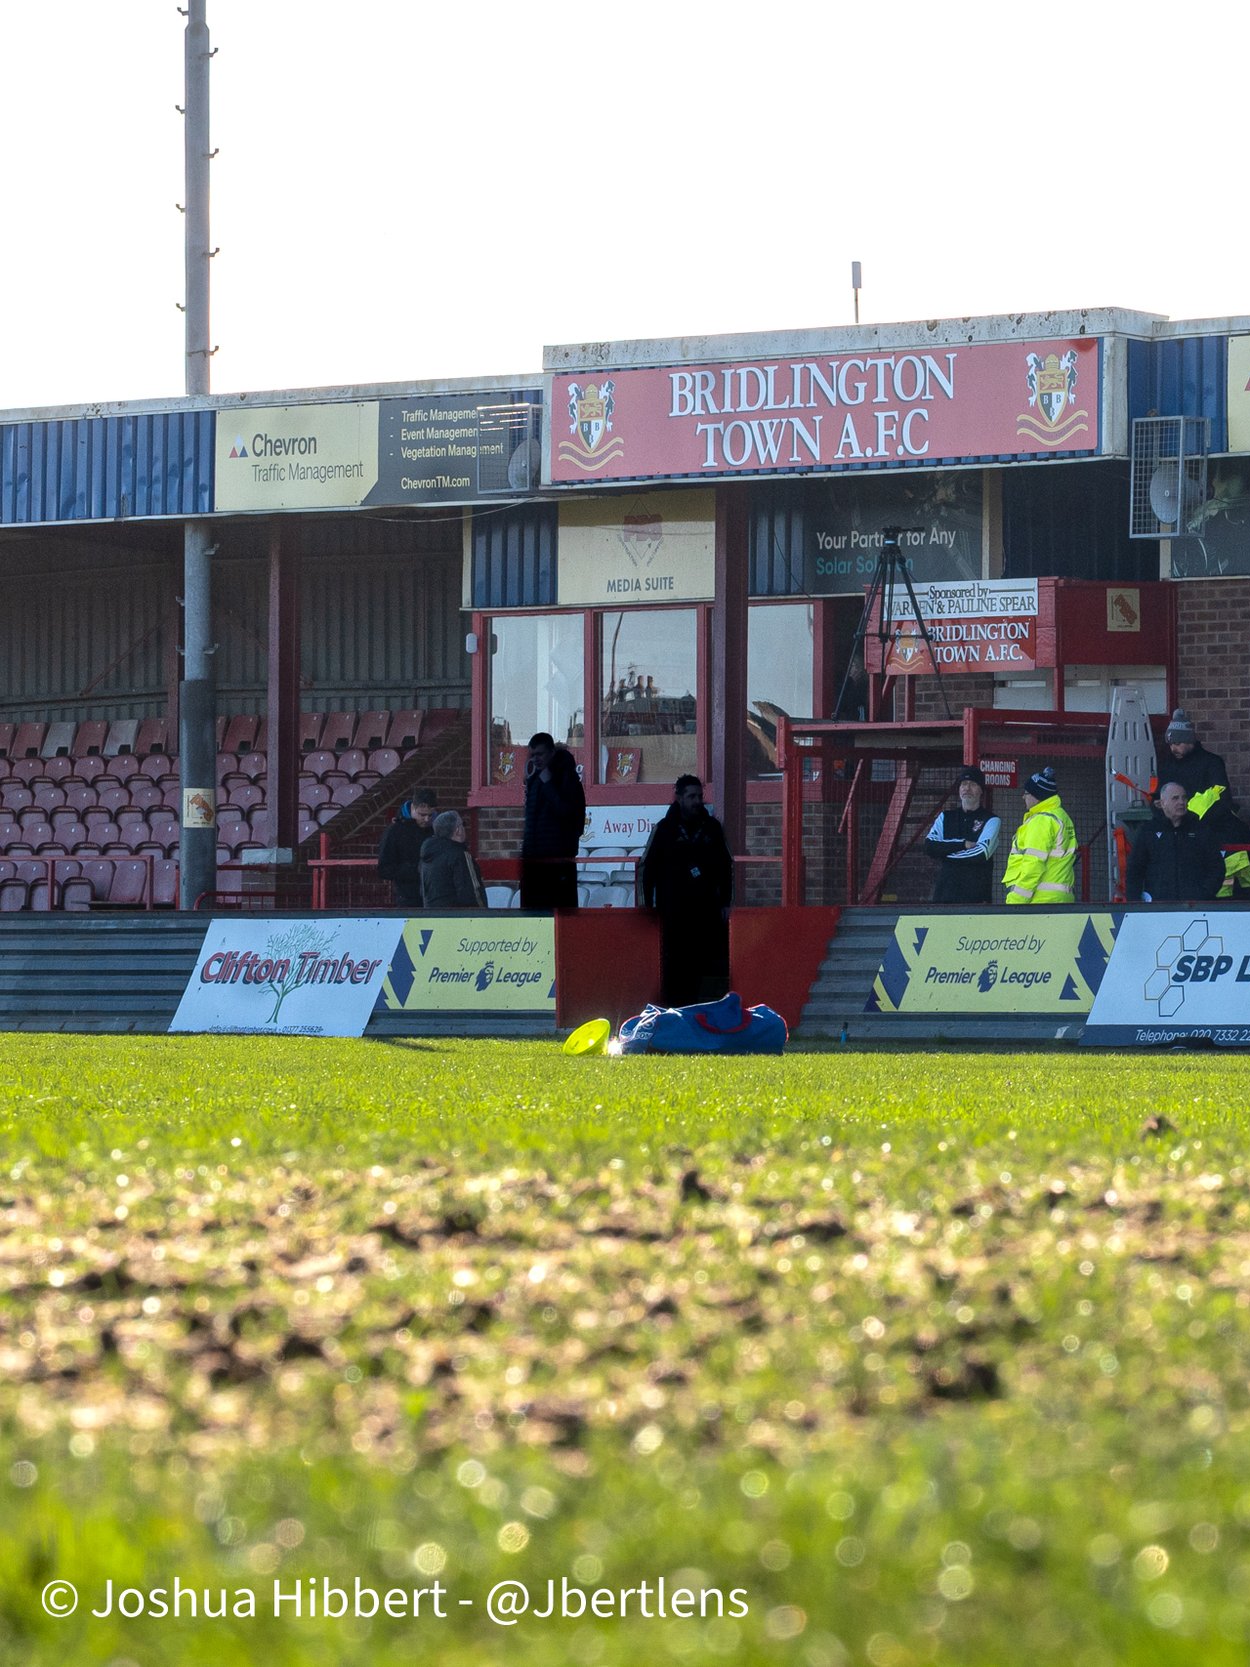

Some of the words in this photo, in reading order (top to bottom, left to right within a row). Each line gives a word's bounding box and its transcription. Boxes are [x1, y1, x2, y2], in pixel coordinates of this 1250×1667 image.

[668, 353, 958, 417] BRIDLINGTON
[401, 410, 428, 422] Traffic
[429, 408, 478, 423] Manageme
[401, 428, 425, 441] Event
[426, 427, 479, 441] Managemen
[695, 415, 824, 468] TOWN
[833, 408, 930, 459] A.F.C
[252, 433, 317, 457] Chevron
[401, 445, 446, 461] Vegetation
[448, 442, 504, 458] Managment
[252, 464, 285, 482] Traffic
[289, 461, 364, 483] Management
[401, 475, 470, 490] ChevronTM.com
[816, 531, 847, 550] Your
[851, 530, 903, 549] Partr
[929, 527, 957, 548] Any
[816, 556, 852, 575] Solar
[606, 578, 642, 593] MEDIA
[645, 576, 674, 591] SUITE
[929, 584, 976, 604] Sponsored
[977, 583, 989, 600] by
[936, 600, 945, 614] &
[947, 598, 997, 614] PAULINE
[999, 596, 1036, 612] SPEAR
[928, 622, 1030, 642] BRIDLINGTON
[935, 645, 980, 663] TOWN
[985, 644, 1023, 662] A.F.C.
[980, 760, 1016, 773] CHANGING
[985, 773, 1010, 786] ROOMS
[603, 819, 634, 838] Away
[457, 937, 520, 955] Supported
[522, 937, 538, 955] by
[956, 935, 1026, 954] Supported
[1027, 935, 1046, 954] by
[201, 951, 290, 985] Clifton
[295, 951, 382, 985] Timber
[428, 966, 475, 983] Premier
[495, 966, 542, 987] League
[924, 966, 977, 984] Premier
[1000, 967, 1051, 988] League
[1171, 955, 1233, 983] SBP
[1213, 1029, 1239, 1041] 7332
